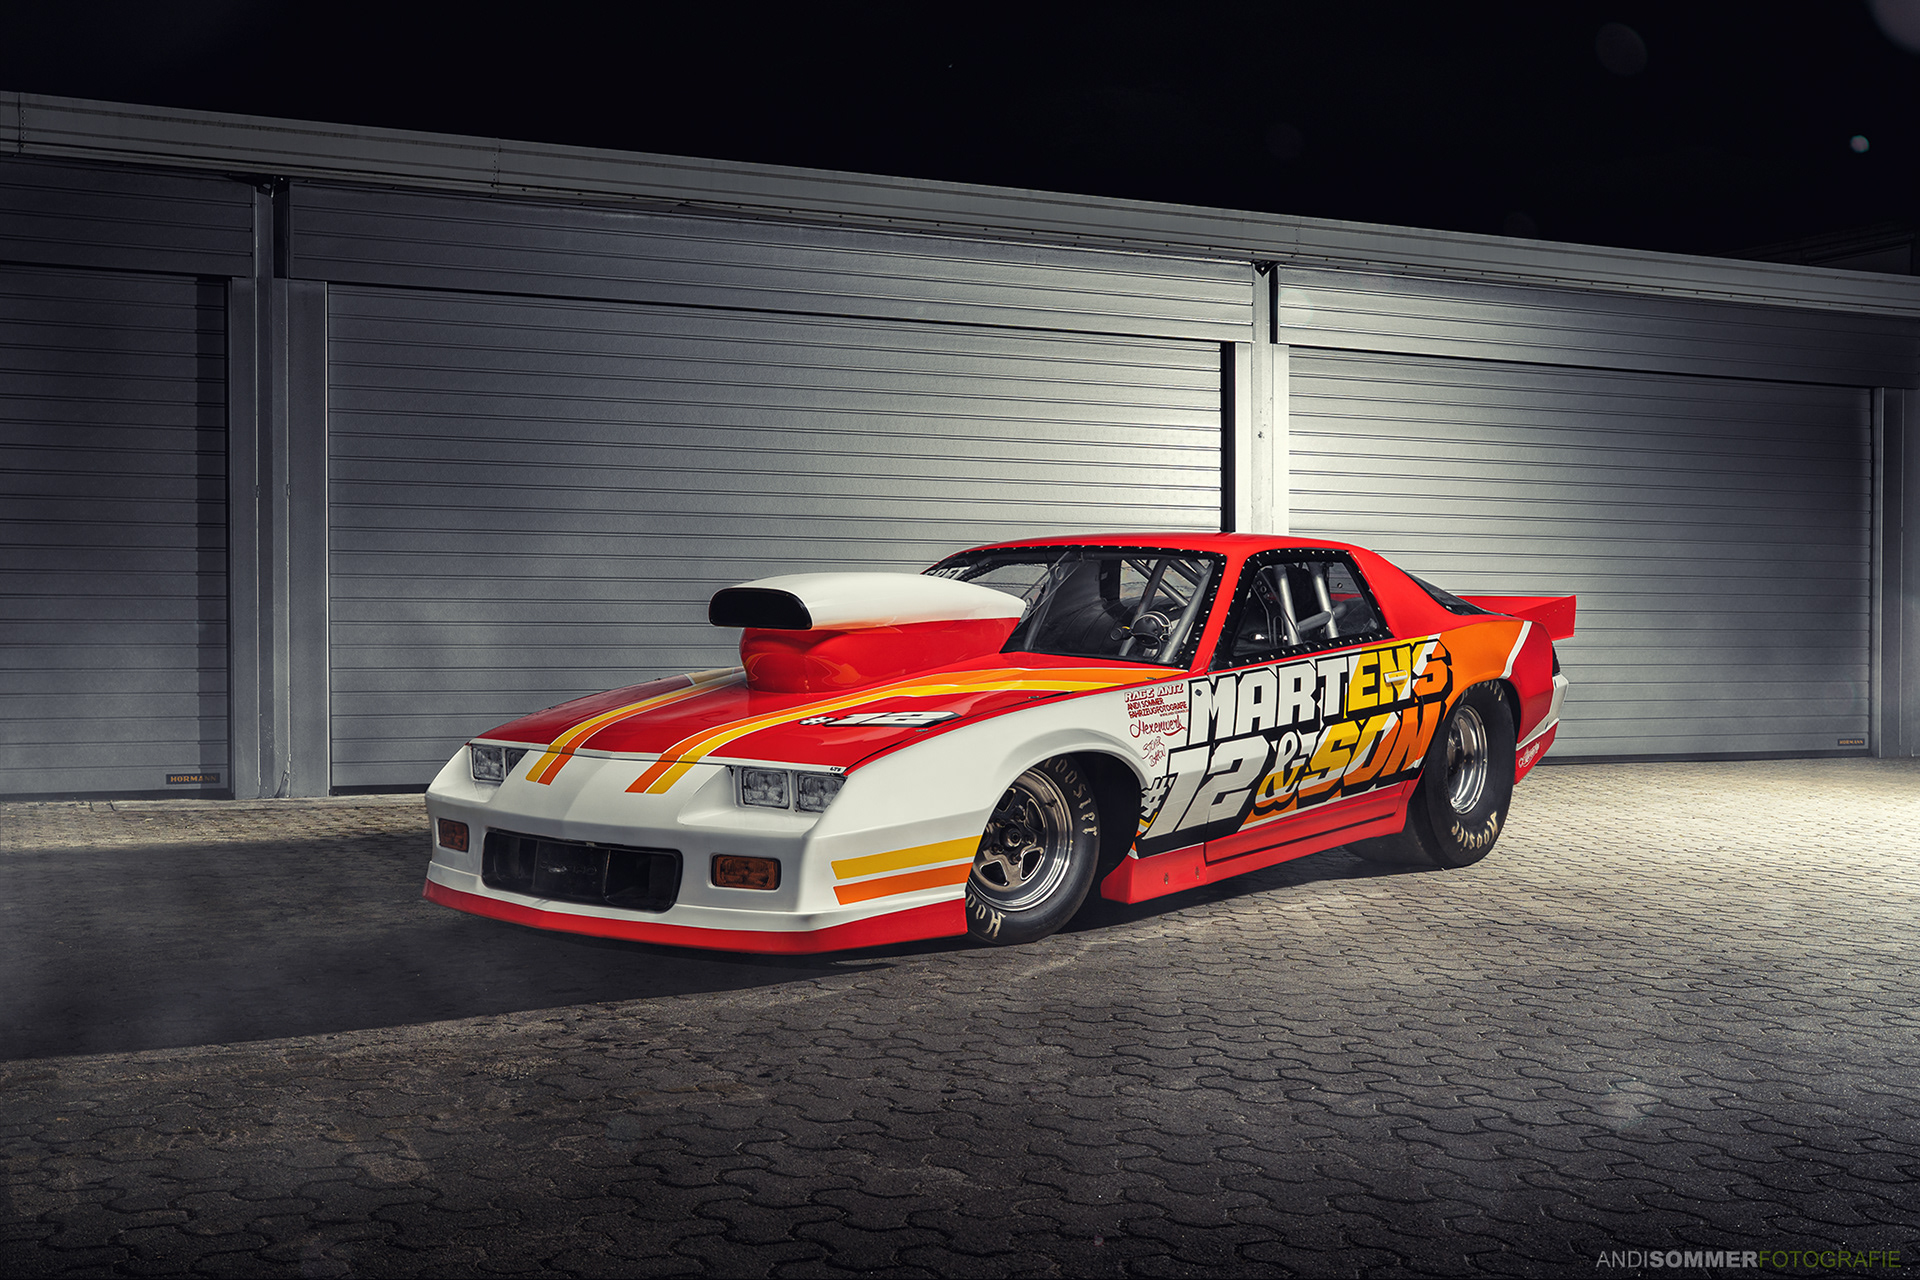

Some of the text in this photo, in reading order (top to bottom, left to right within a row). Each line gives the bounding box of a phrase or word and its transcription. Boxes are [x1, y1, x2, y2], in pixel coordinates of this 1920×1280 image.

[1127, 697, 1165, 710] ANDI SOMMER
[1188, 640, 1453, 747] MARTENS
[1254, 731, 1310, 812] &
[1295, 700, 1447, 802] SON
